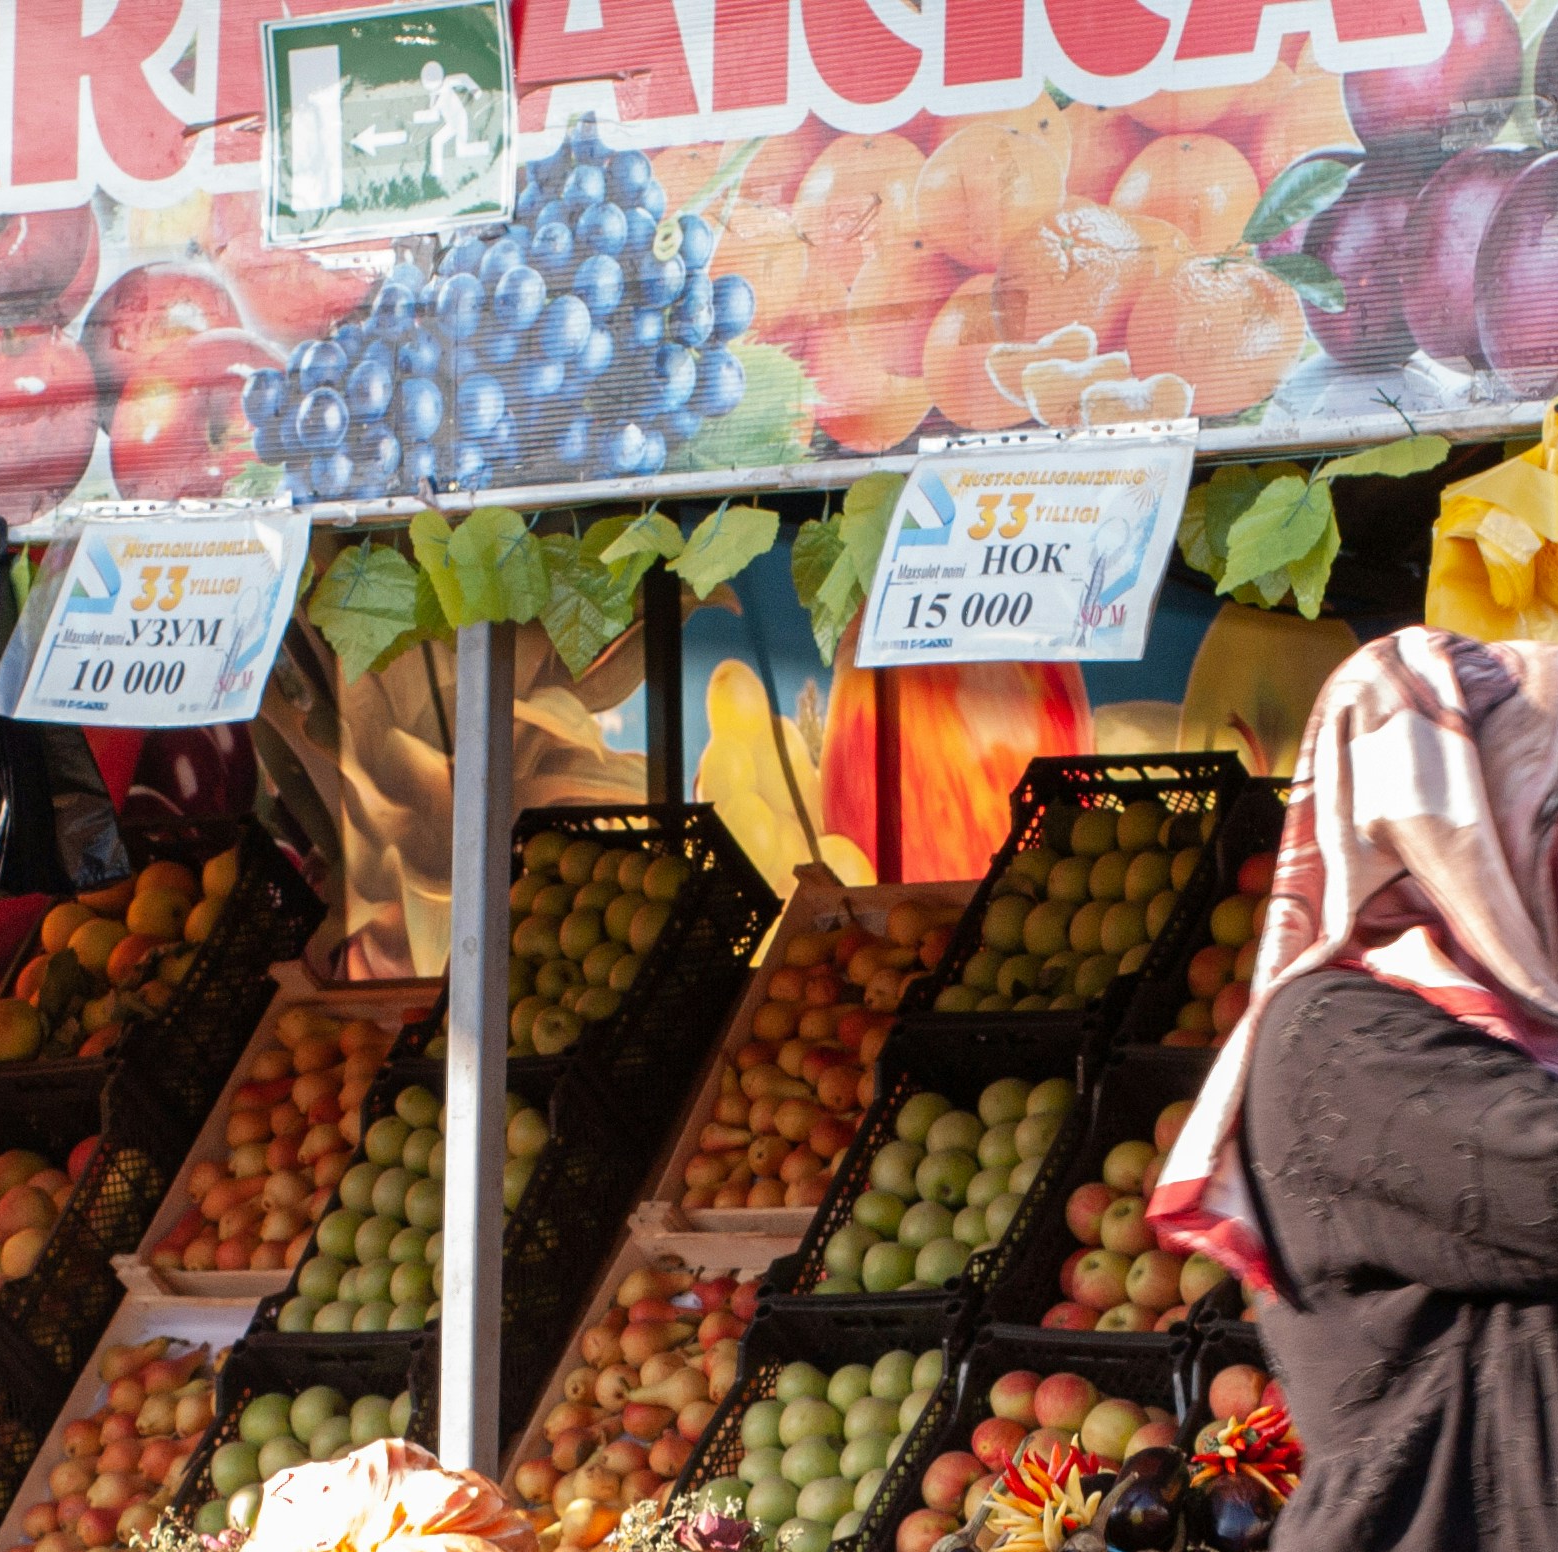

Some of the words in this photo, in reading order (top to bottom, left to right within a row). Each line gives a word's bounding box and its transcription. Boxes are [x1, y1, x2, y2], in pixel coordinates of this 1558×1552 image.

[967, 492, 1035, 540] 33
[1035, 504, 1101, 523] YILLIGI
[130, 564, 190, 612] 33
[189, 577, 242, 596] YILLIGI
[897, 562, 941, 580] Maxsulot
[942, 563, 967, 579] nomi
[903, 592, 952, 630] 15
[960, 591, 1033, 629] 000
[126, 618, 224, 647] УЗУМ
[70, 659, 114, 692] 10
[123, 660, 185, 695] 000
